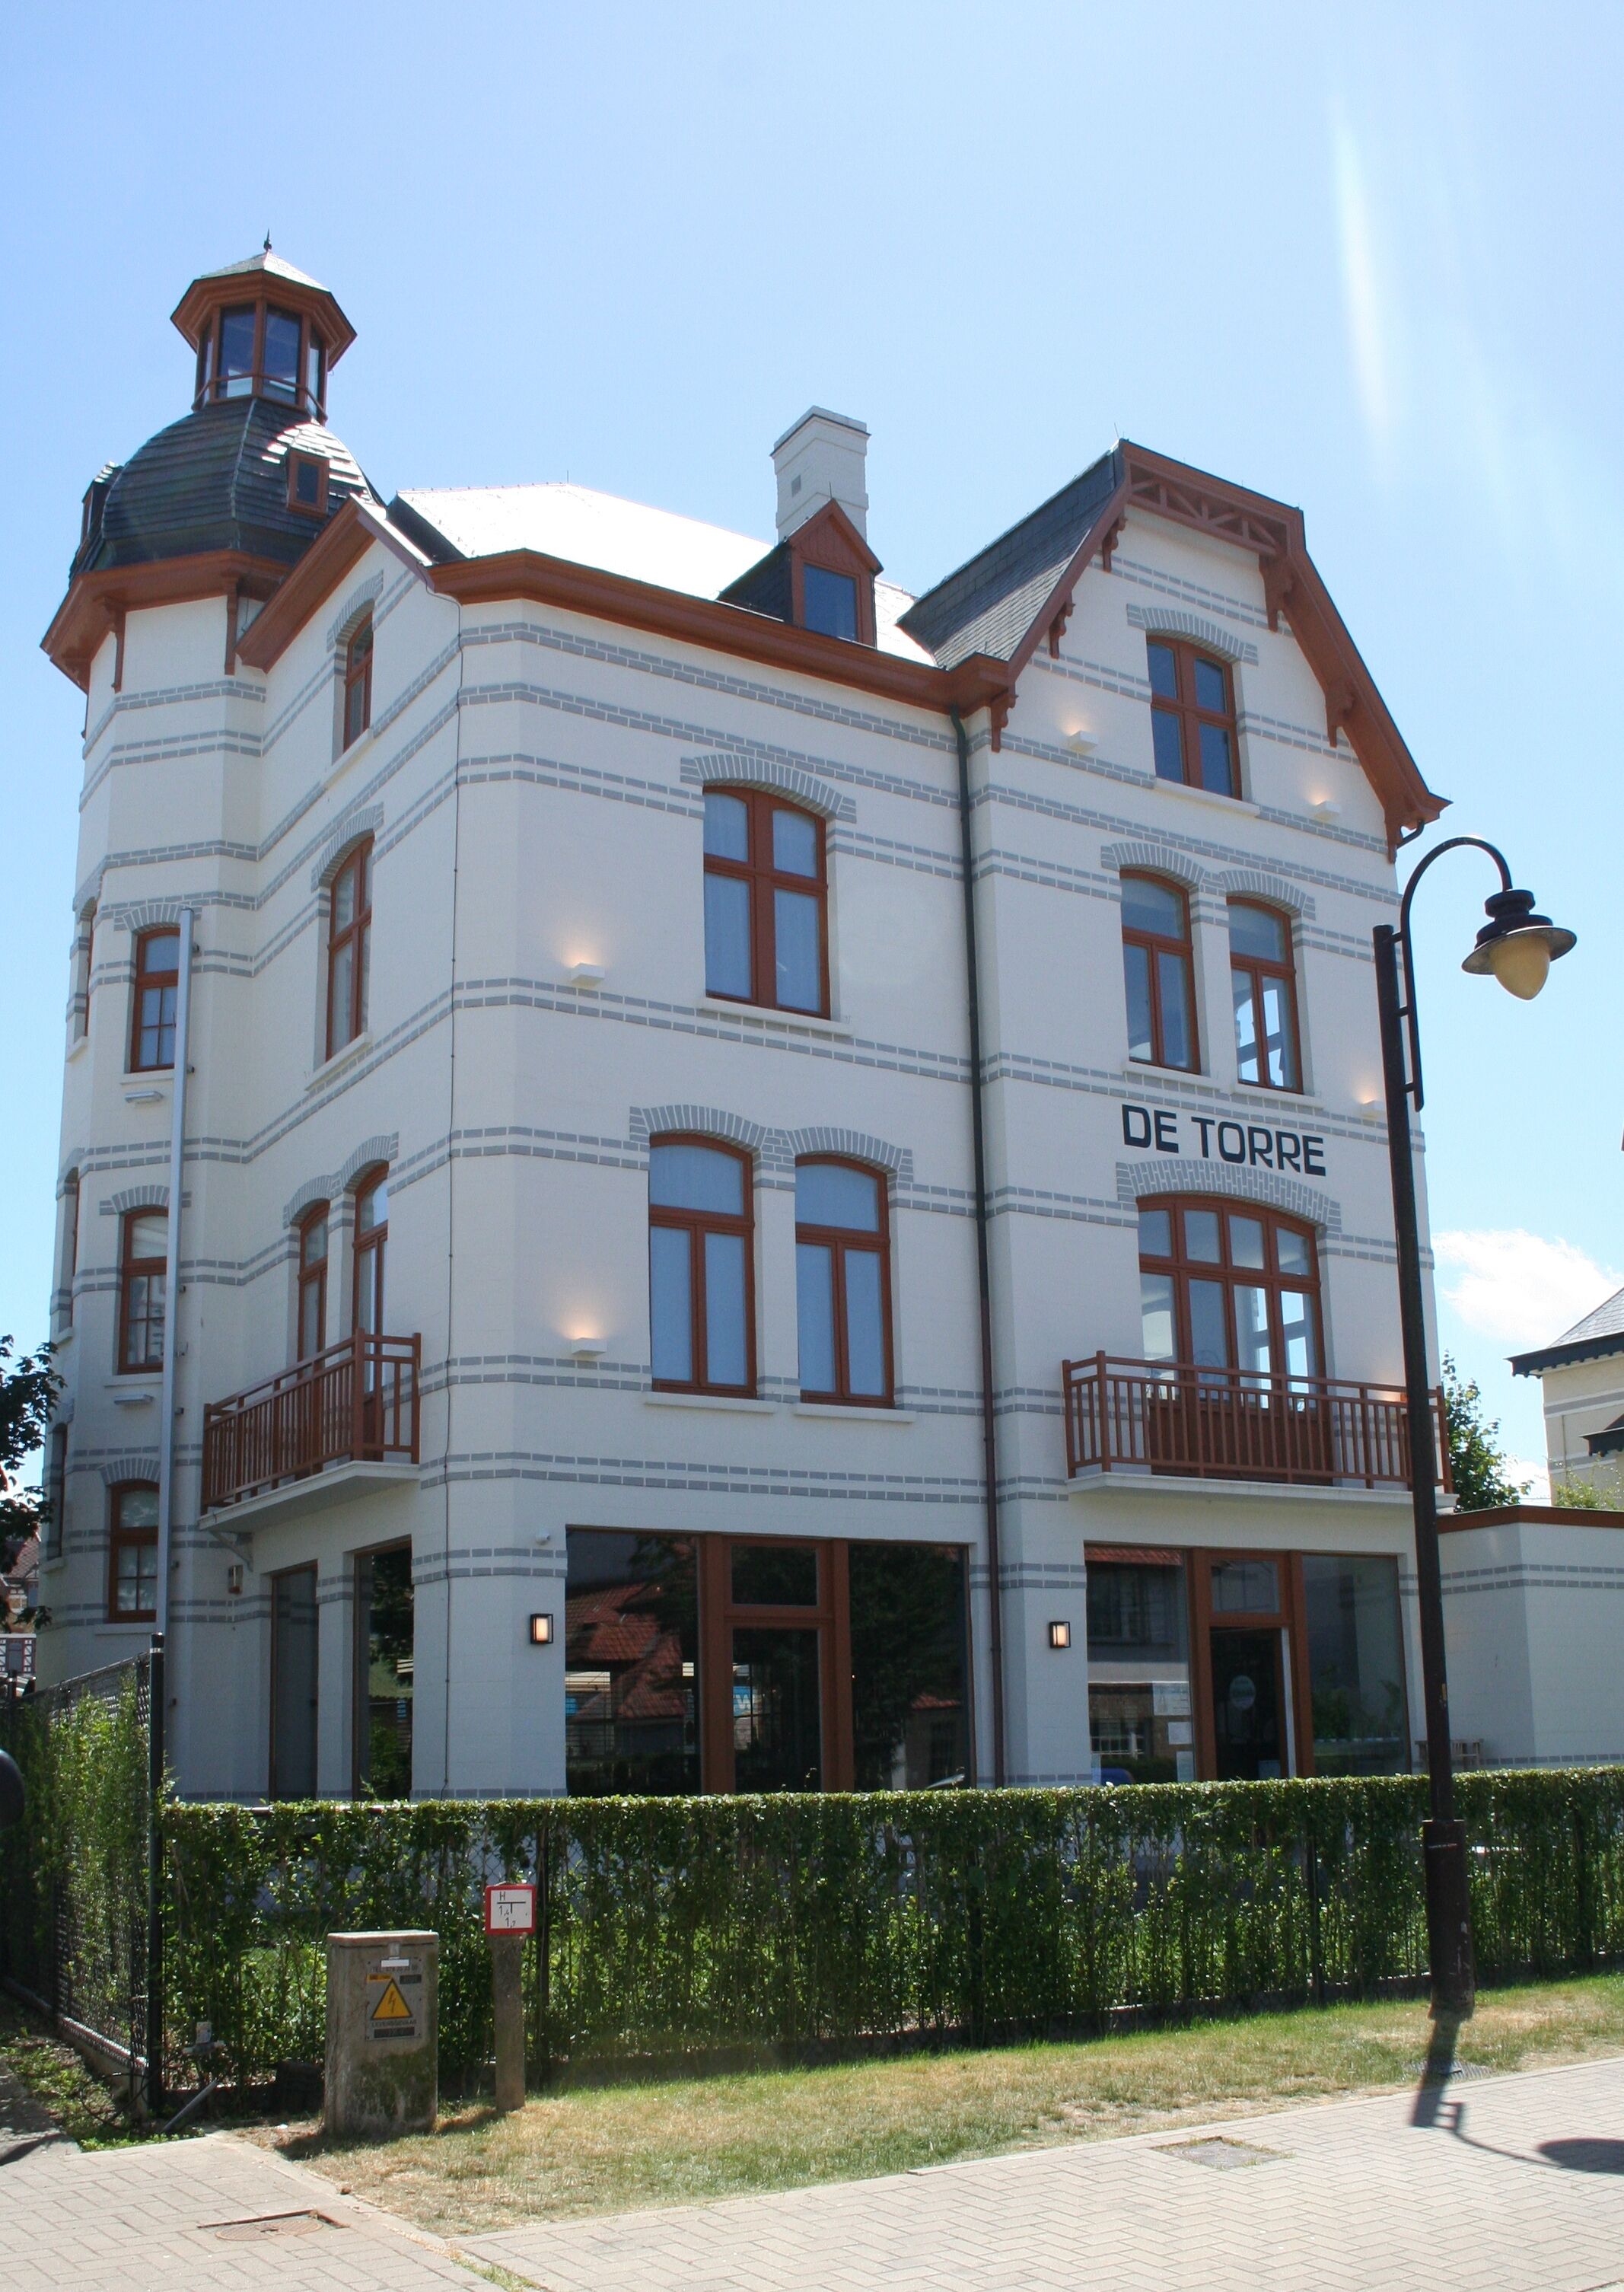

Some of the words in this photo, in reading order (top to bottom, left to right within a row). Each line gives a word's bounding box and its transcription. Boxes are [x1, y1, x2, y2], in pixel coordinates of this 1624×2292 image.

[1122, 1104, 1179, 1154] DE
[1191, 1116, 1326, 1177] TORRE
[499, 1891, 506, 1901] H
